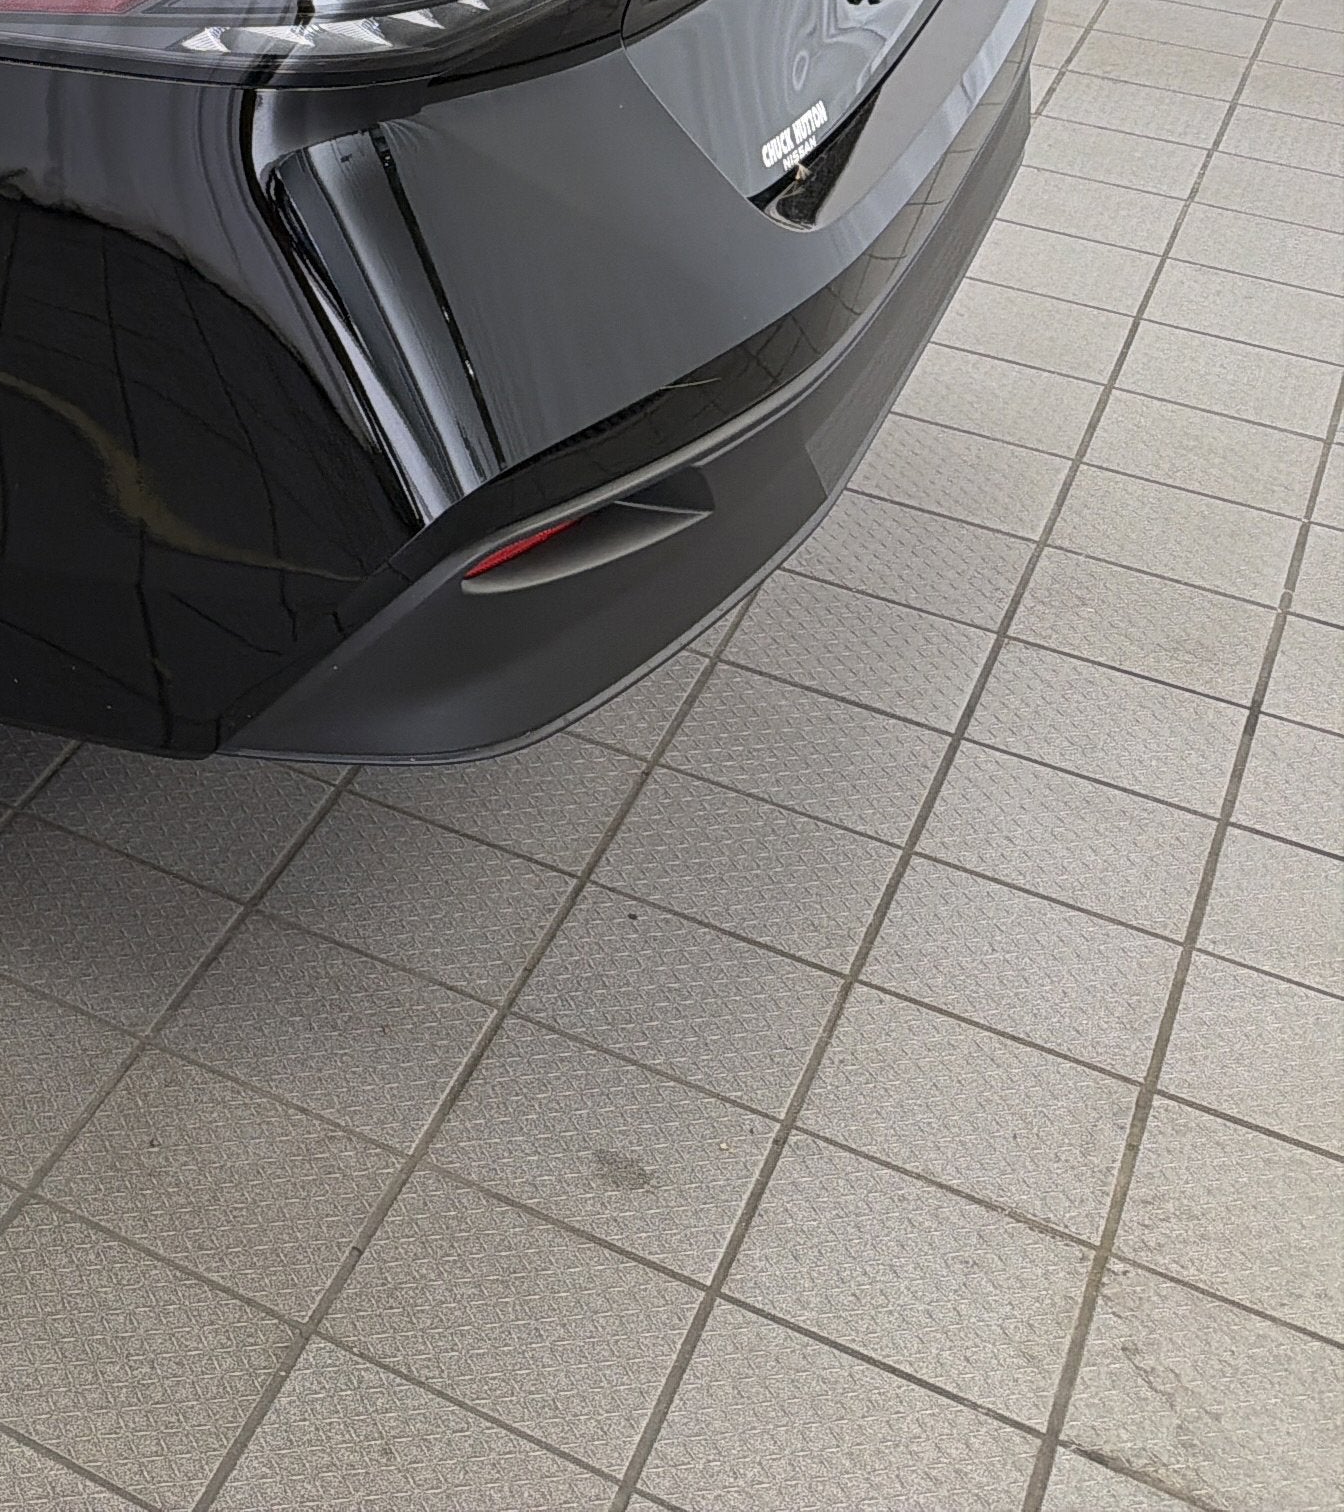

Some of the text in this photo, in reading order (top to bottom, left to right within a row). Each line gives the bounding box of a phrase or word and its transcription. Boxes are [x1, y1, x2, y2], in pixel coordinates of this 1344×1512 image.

[762, 100, 827, 167] CHUCK HUTTON
[783, 135, 816, 171] NISSAN
